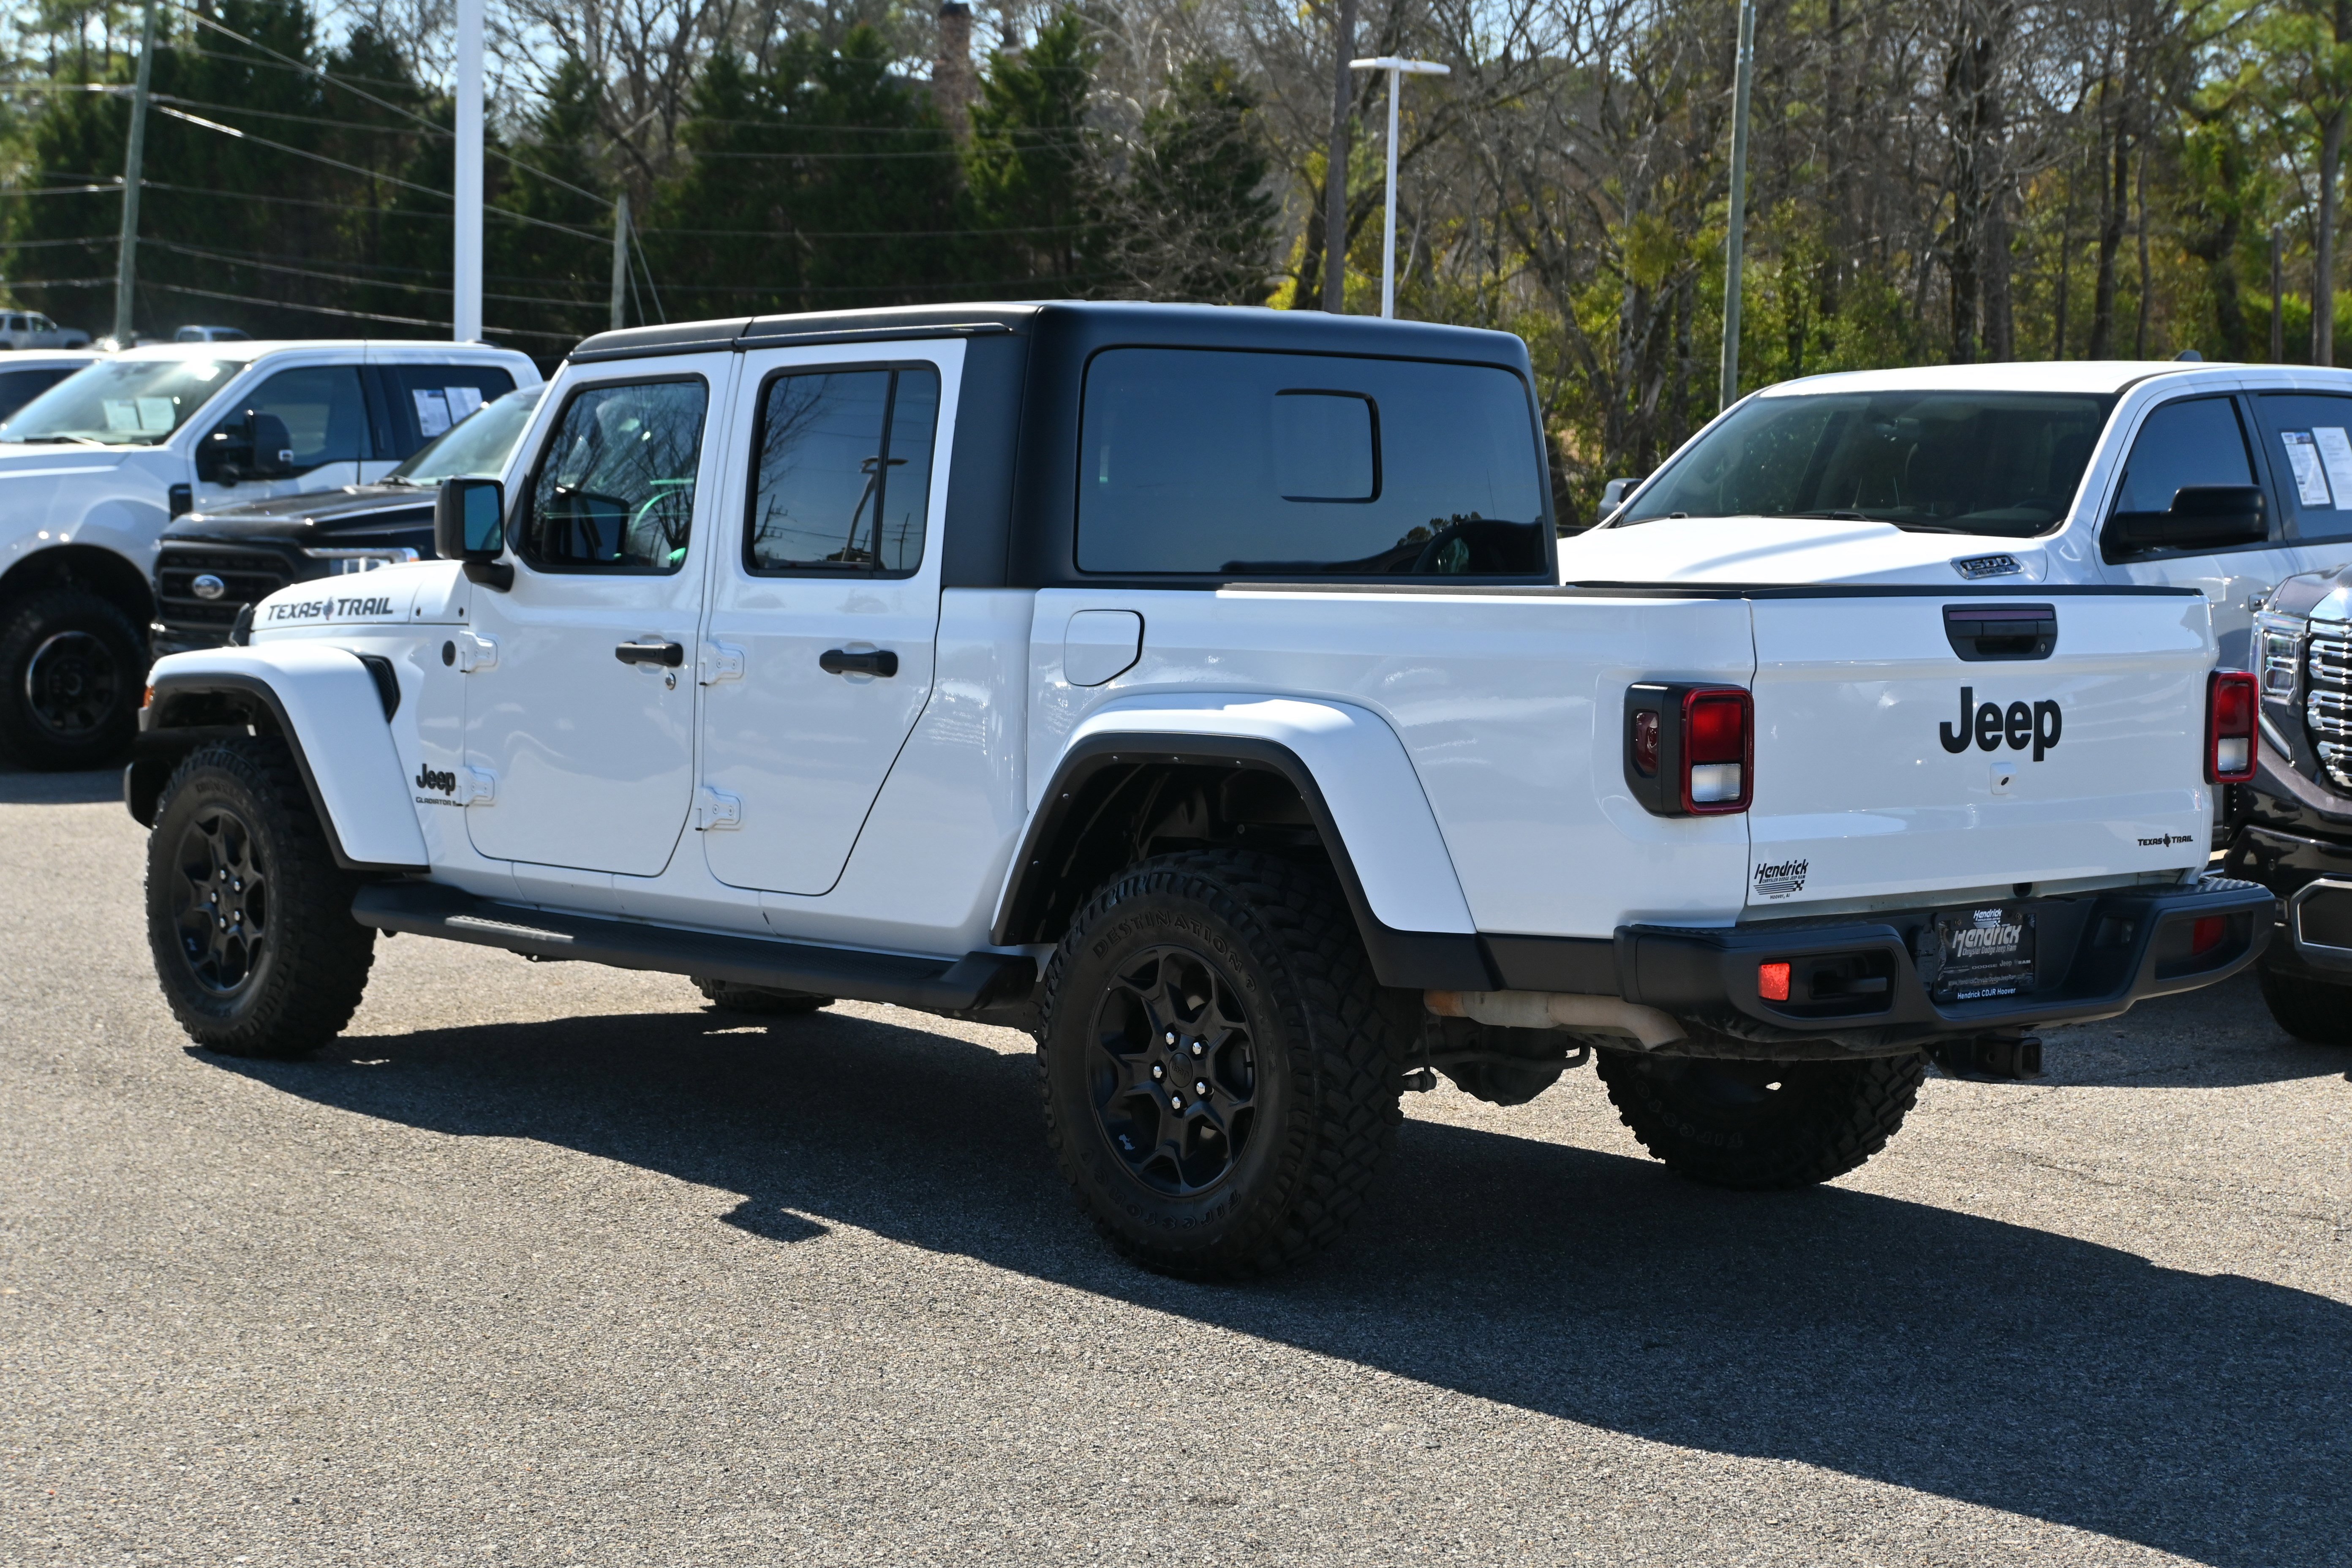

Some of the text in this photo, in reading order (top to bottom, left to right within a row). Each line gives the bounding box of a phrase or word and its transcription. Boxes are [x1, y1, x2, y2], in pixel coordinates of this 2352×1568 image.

[1964, 557, 2011, 570] 1500
[268, 597, 394, 621] TEXAS TRAIL
[1940, 686, 2062, 762] Jeep
[416, 763, 455, 796] Jeep
[416, 797, 451, 806] GLADIATOR
[2137, 835, 2193, 846] TEXAS TRAIL
[1754, 859, 1809, 884] Hendrick
[1973, 908, 2002, 921] Hendrick
[1092, 910, 1243, 973] DESTINATION
[1952, 925, 2022, 957] Hendrick
[1962, 948, 1981, 957] Chrysler
[1981, 946, 1995, 955] Dodge
[1995, 946, 2006, 954] Jeep
[1957, 988, 2016, 999] Hendrick CDJR Hoover
[1172, 1062, 1190, 1079] Jeep
[1623, 1057, 1744, 1149] Fireston
[1094, 1168, 1241, 1231] Firestone
